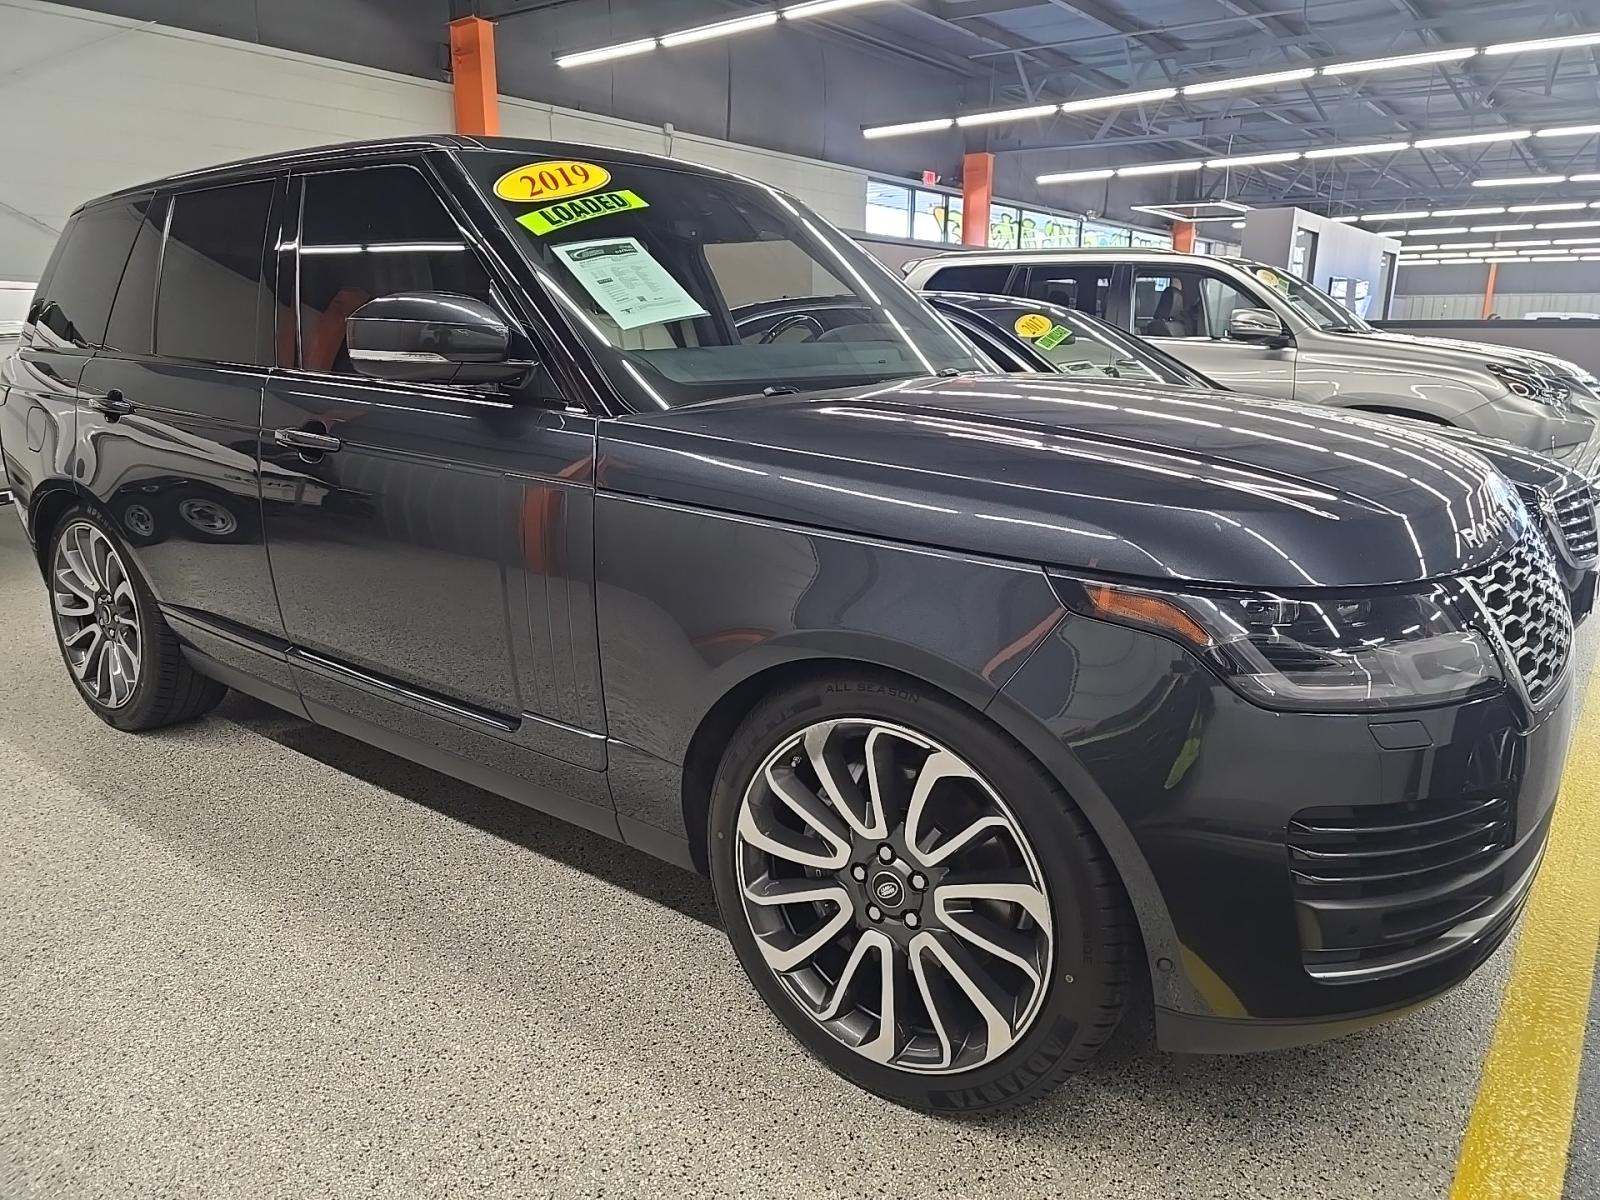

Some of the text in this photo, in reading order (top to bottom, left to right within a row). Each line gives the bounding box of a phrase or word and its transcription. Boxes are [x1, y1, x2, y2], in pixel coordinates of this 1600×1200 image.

[520, 164, 590, 197] 2019
[538, 193, 630, 226] LOADED
[823, 682, 921, 704] ALL SEASON
